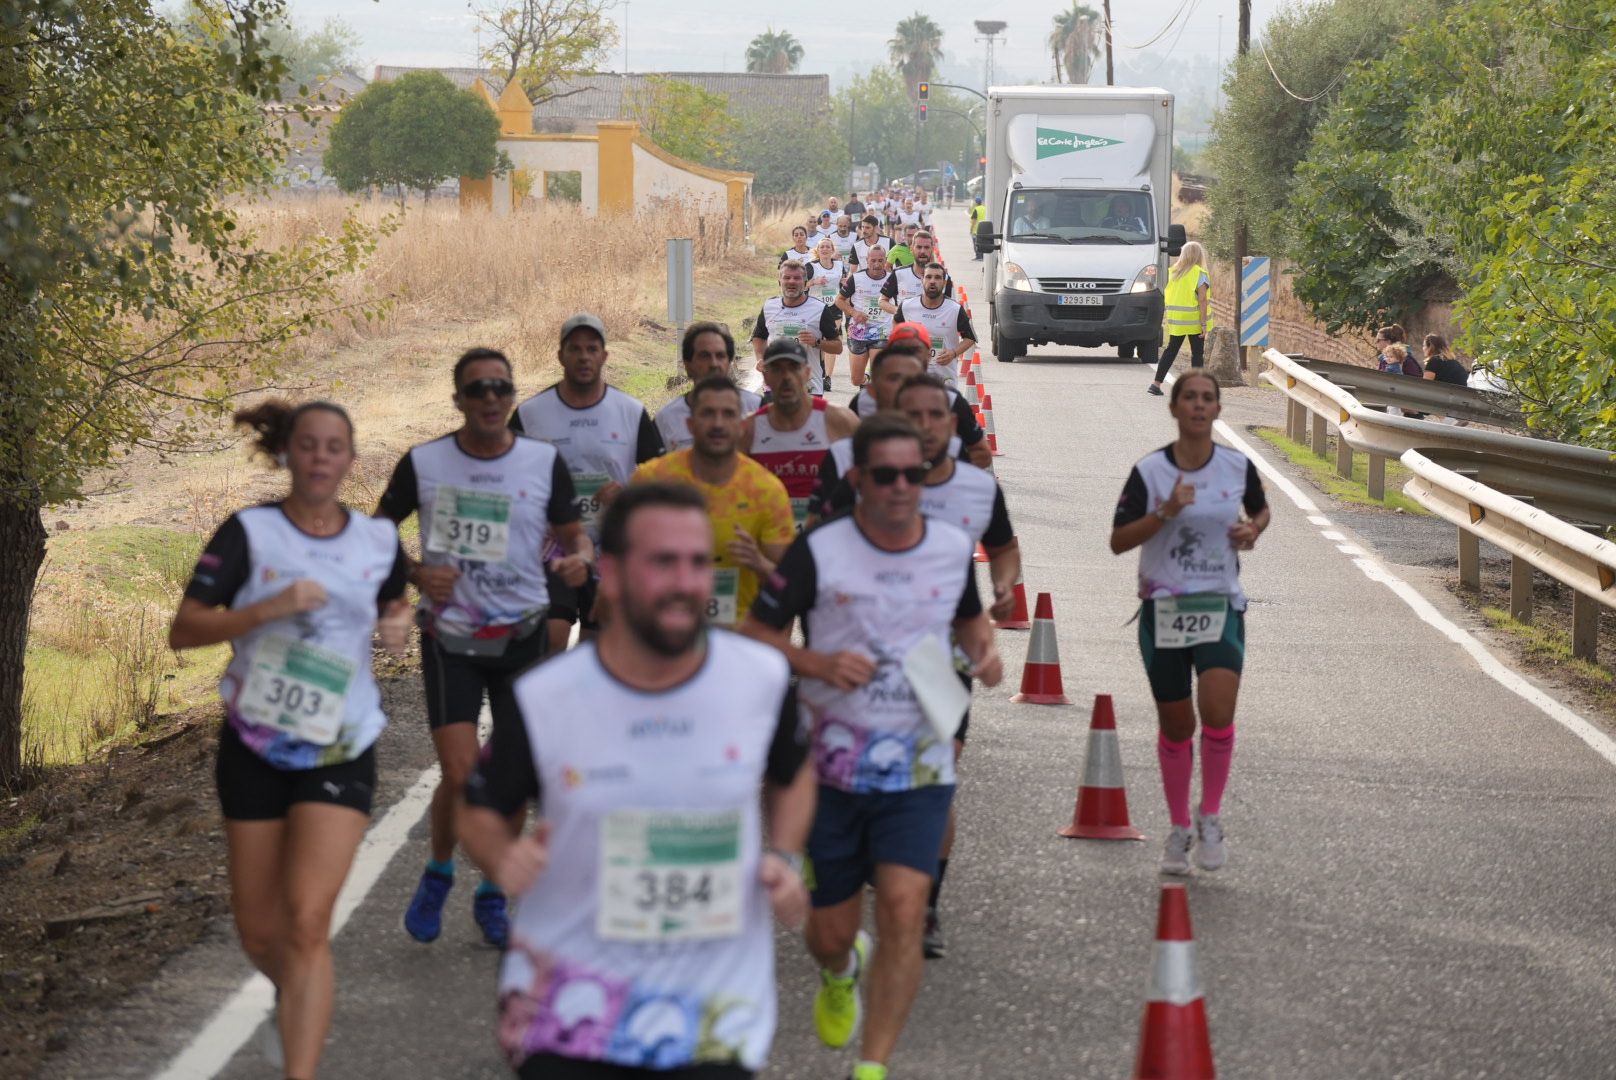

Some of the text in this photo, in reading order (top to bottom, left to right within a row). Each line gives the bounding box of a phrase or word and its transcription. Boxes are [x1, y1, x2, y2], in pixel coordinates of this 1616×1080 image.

[1037, 137, 1048, 146] El
[1049, 137, 1073, 146] Corte
[1063, 296, 1101, 305] 3293 FSL
[447, 519, 491, 544] 319
[1172, 614, 1210, 633] 420
[264, 678, 323, 717] 303
[633, 869, 713, 913] 384
